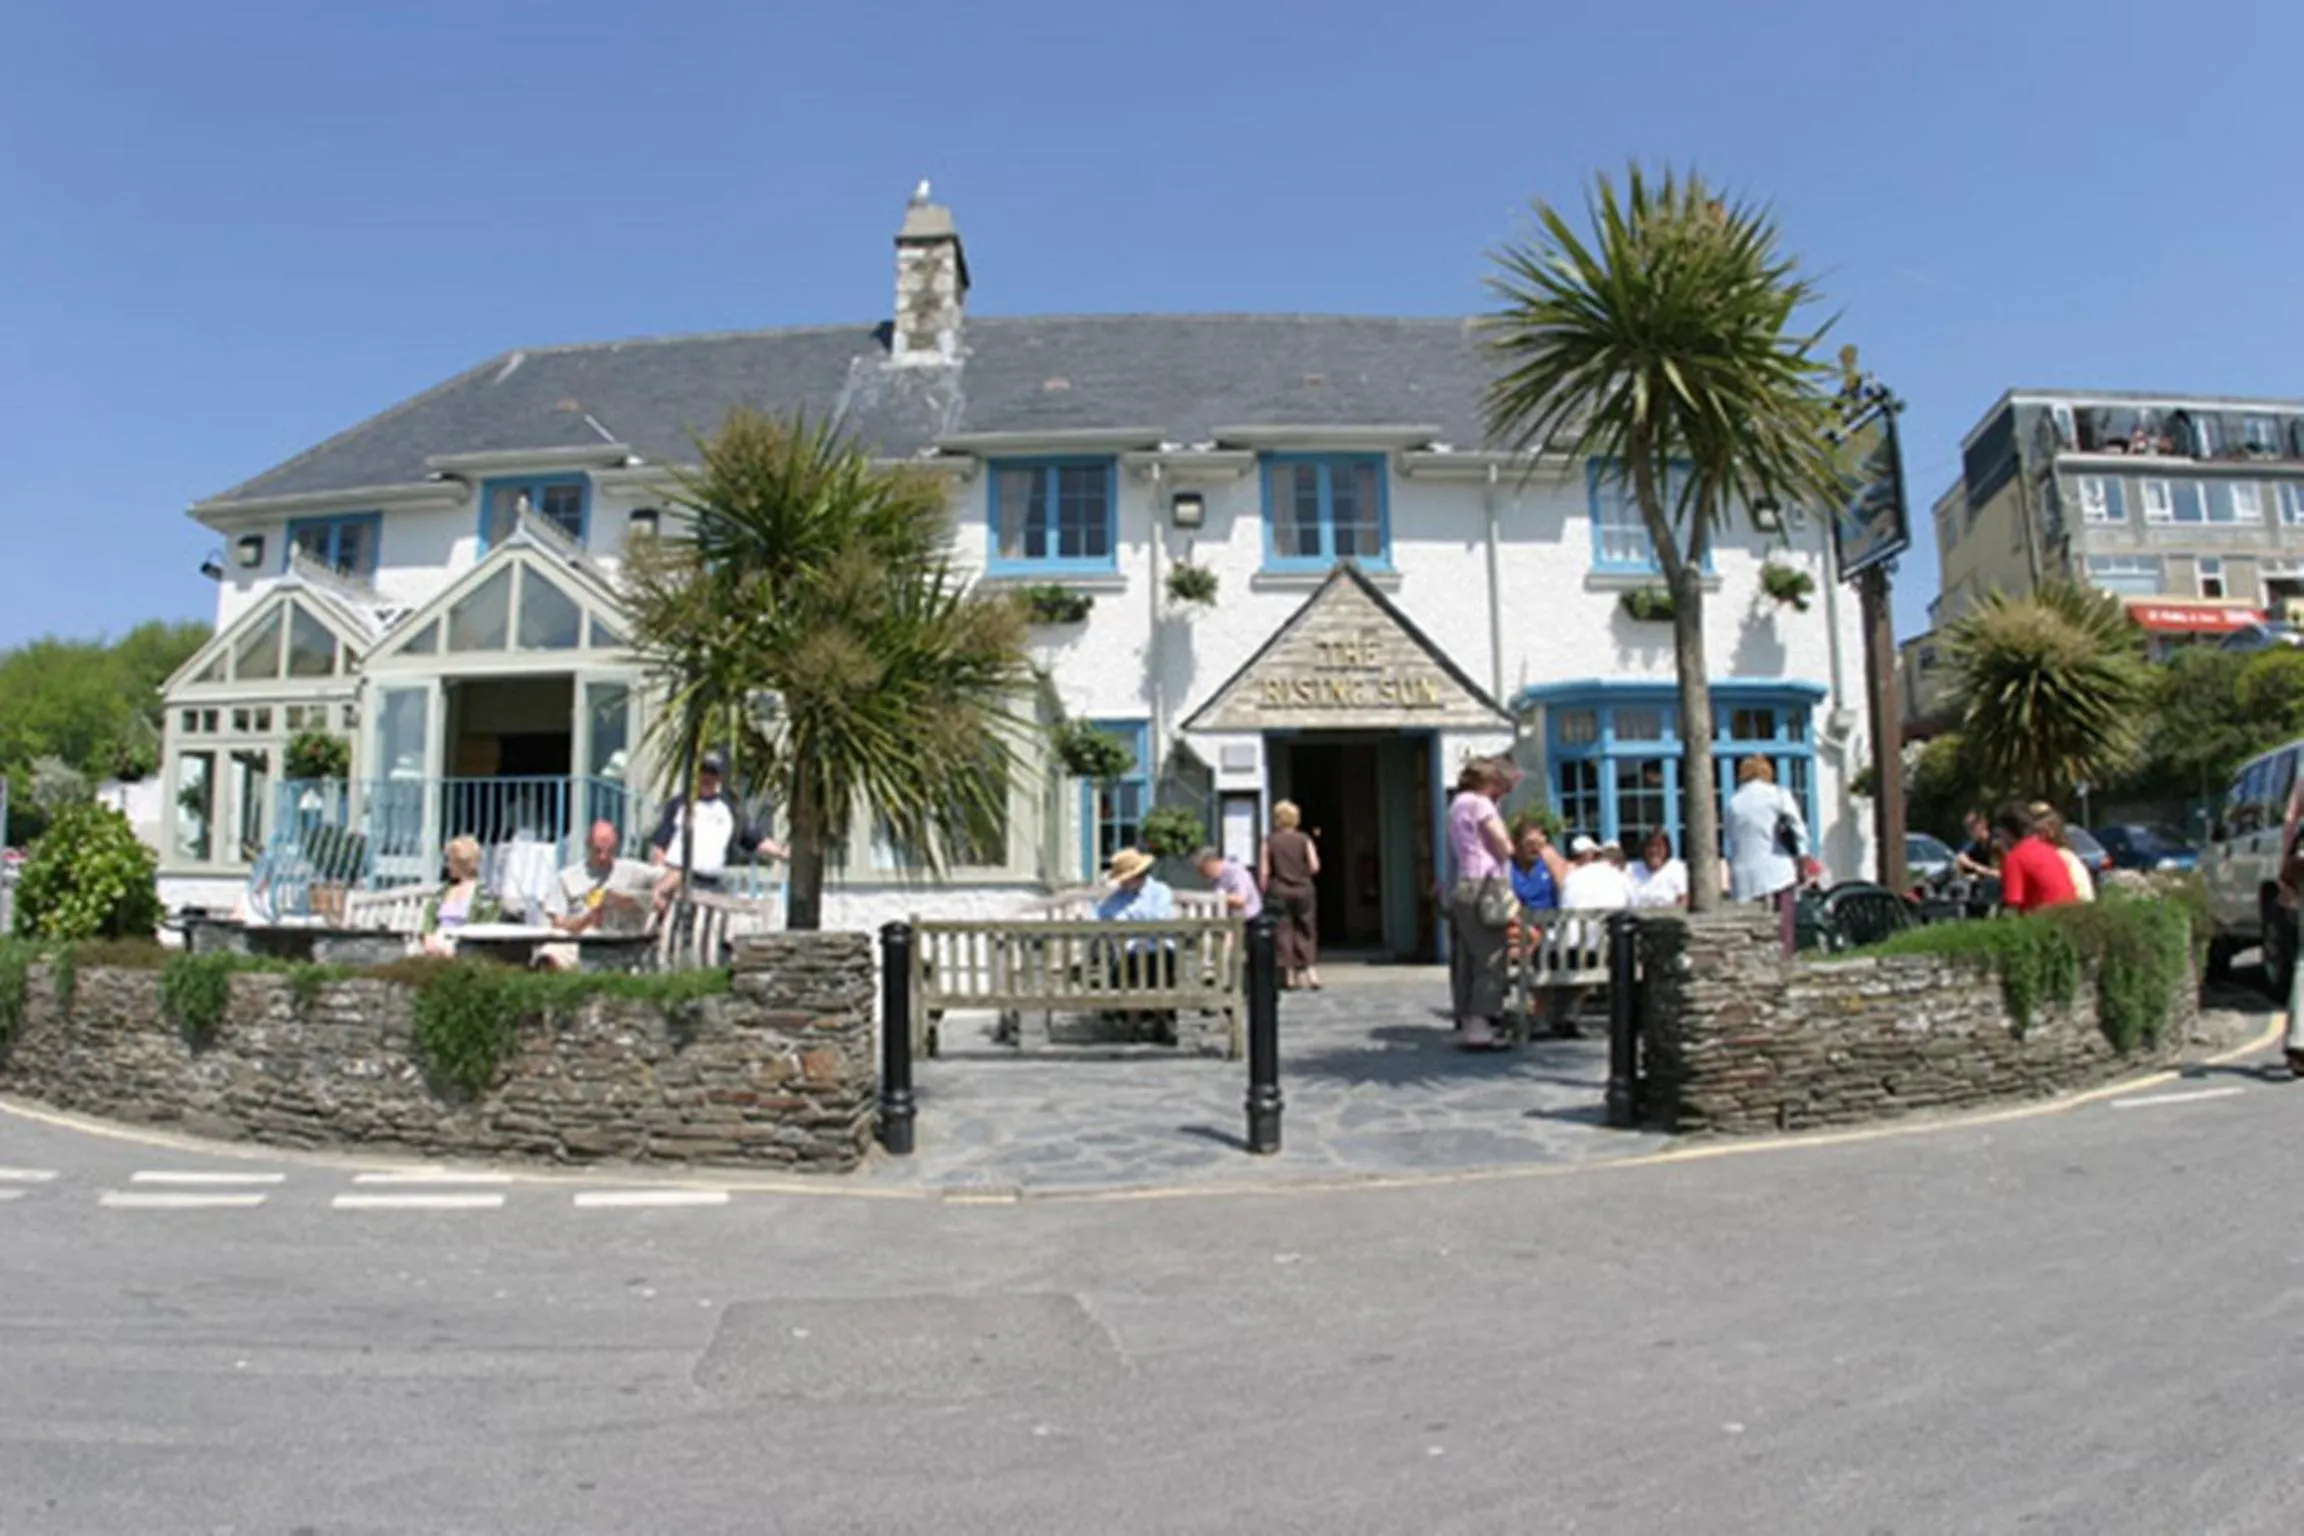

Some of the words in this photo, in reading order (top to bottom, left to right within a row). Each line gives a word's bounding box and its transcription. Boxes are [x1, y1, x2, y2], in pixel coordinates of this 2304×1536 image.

[1316, 641, 1383, 666] THE
[1261, 677, 1366, 706] RISING
[1378, 677, 1440, 706] SUN
